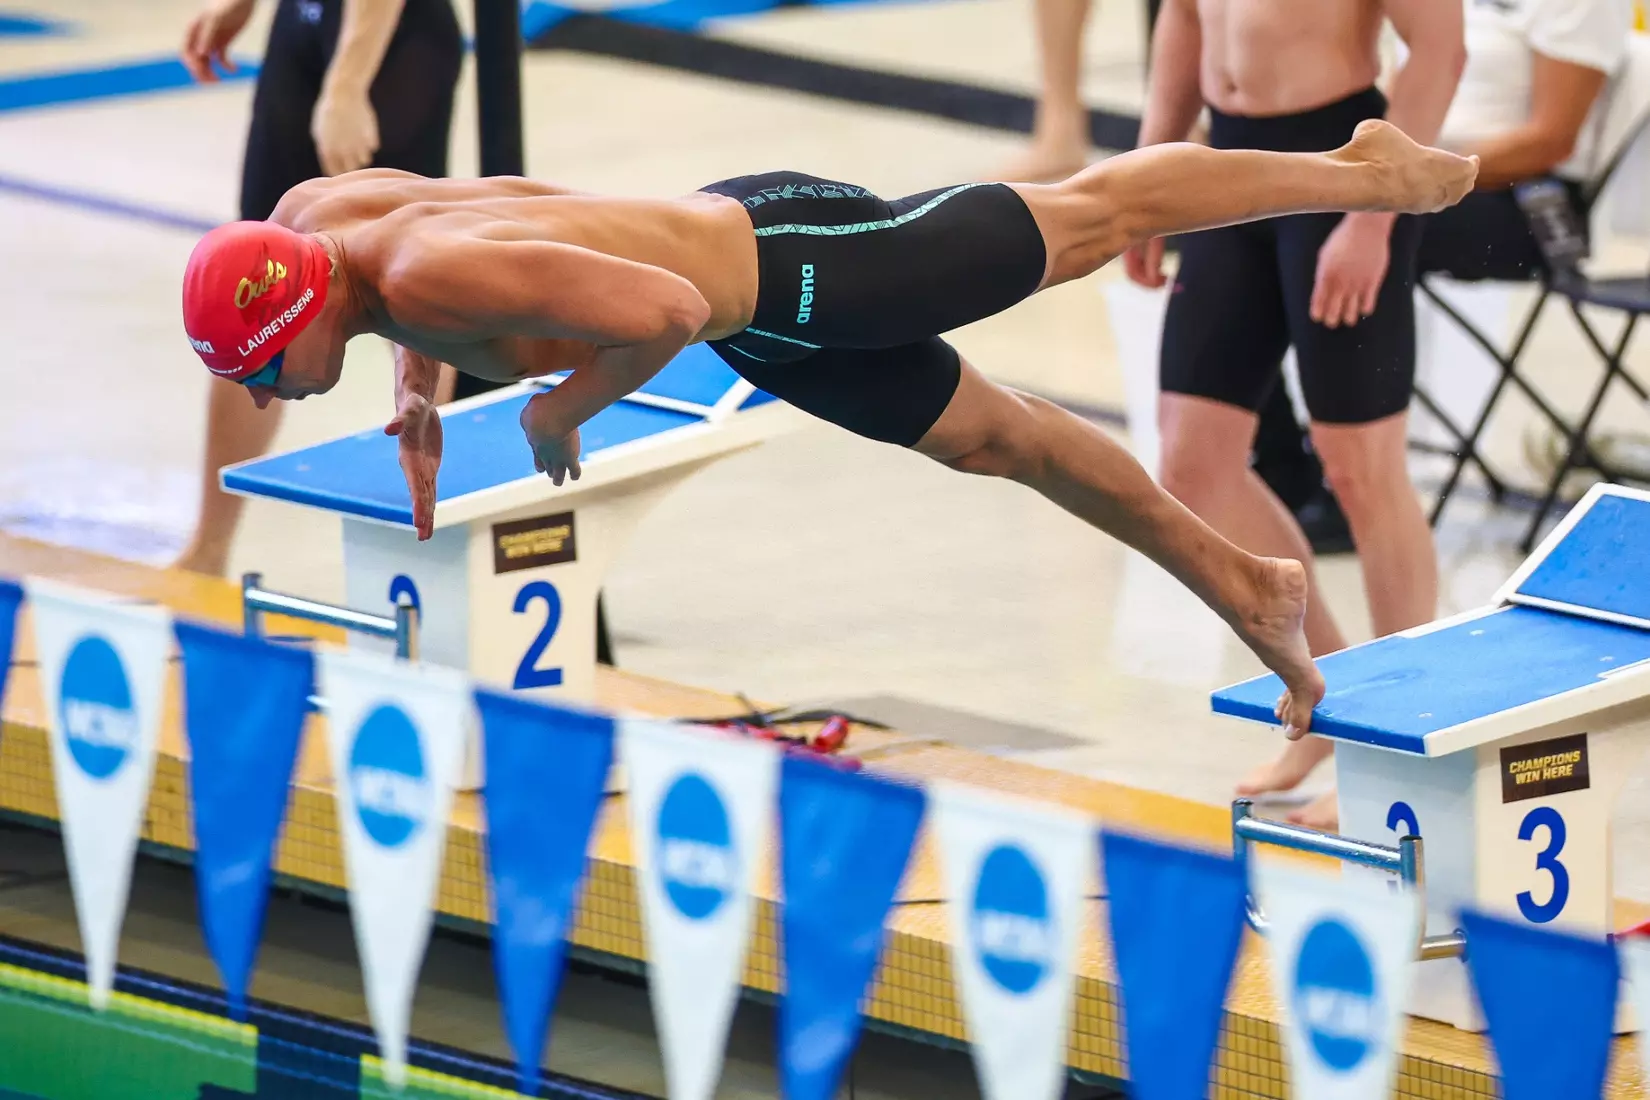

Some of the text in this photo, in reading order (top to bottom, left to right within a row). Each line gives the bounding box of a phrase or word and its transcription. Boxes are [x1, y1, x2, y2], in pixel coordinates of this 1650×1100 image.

[796, 264, 814, 324] arena
[512, 580, 563, 690] 2
[1509, 750, 1581, 773] CHAMPIONS
[1516, 764, 1573, 785] WIN HERE
[1516, 806, 1570, 924] 3
